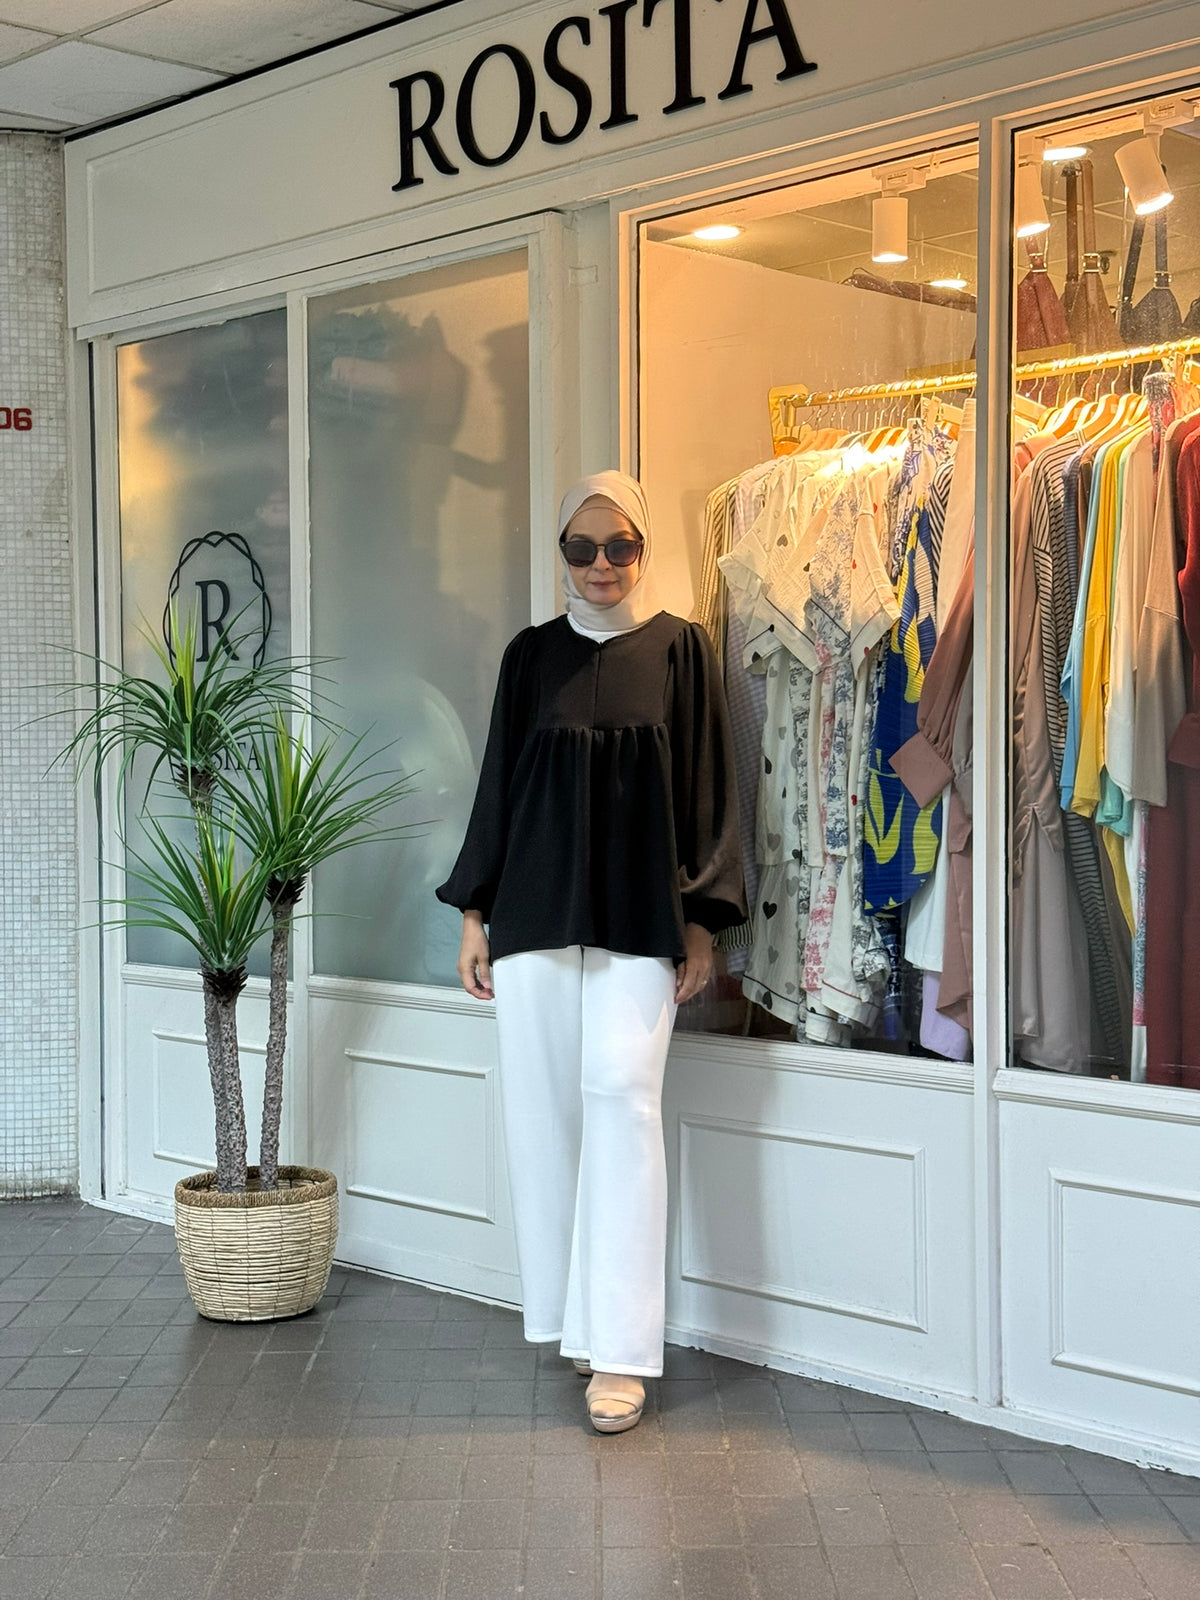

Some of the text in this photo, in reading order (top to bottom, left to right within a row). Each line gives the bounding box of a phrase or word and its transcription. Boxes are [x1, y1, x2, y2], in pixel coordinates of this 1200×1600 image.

[389, 0, 818, 191] ROSITA
[195, 579, 240, 662] R
[206, 741, 262, 771] SITA
